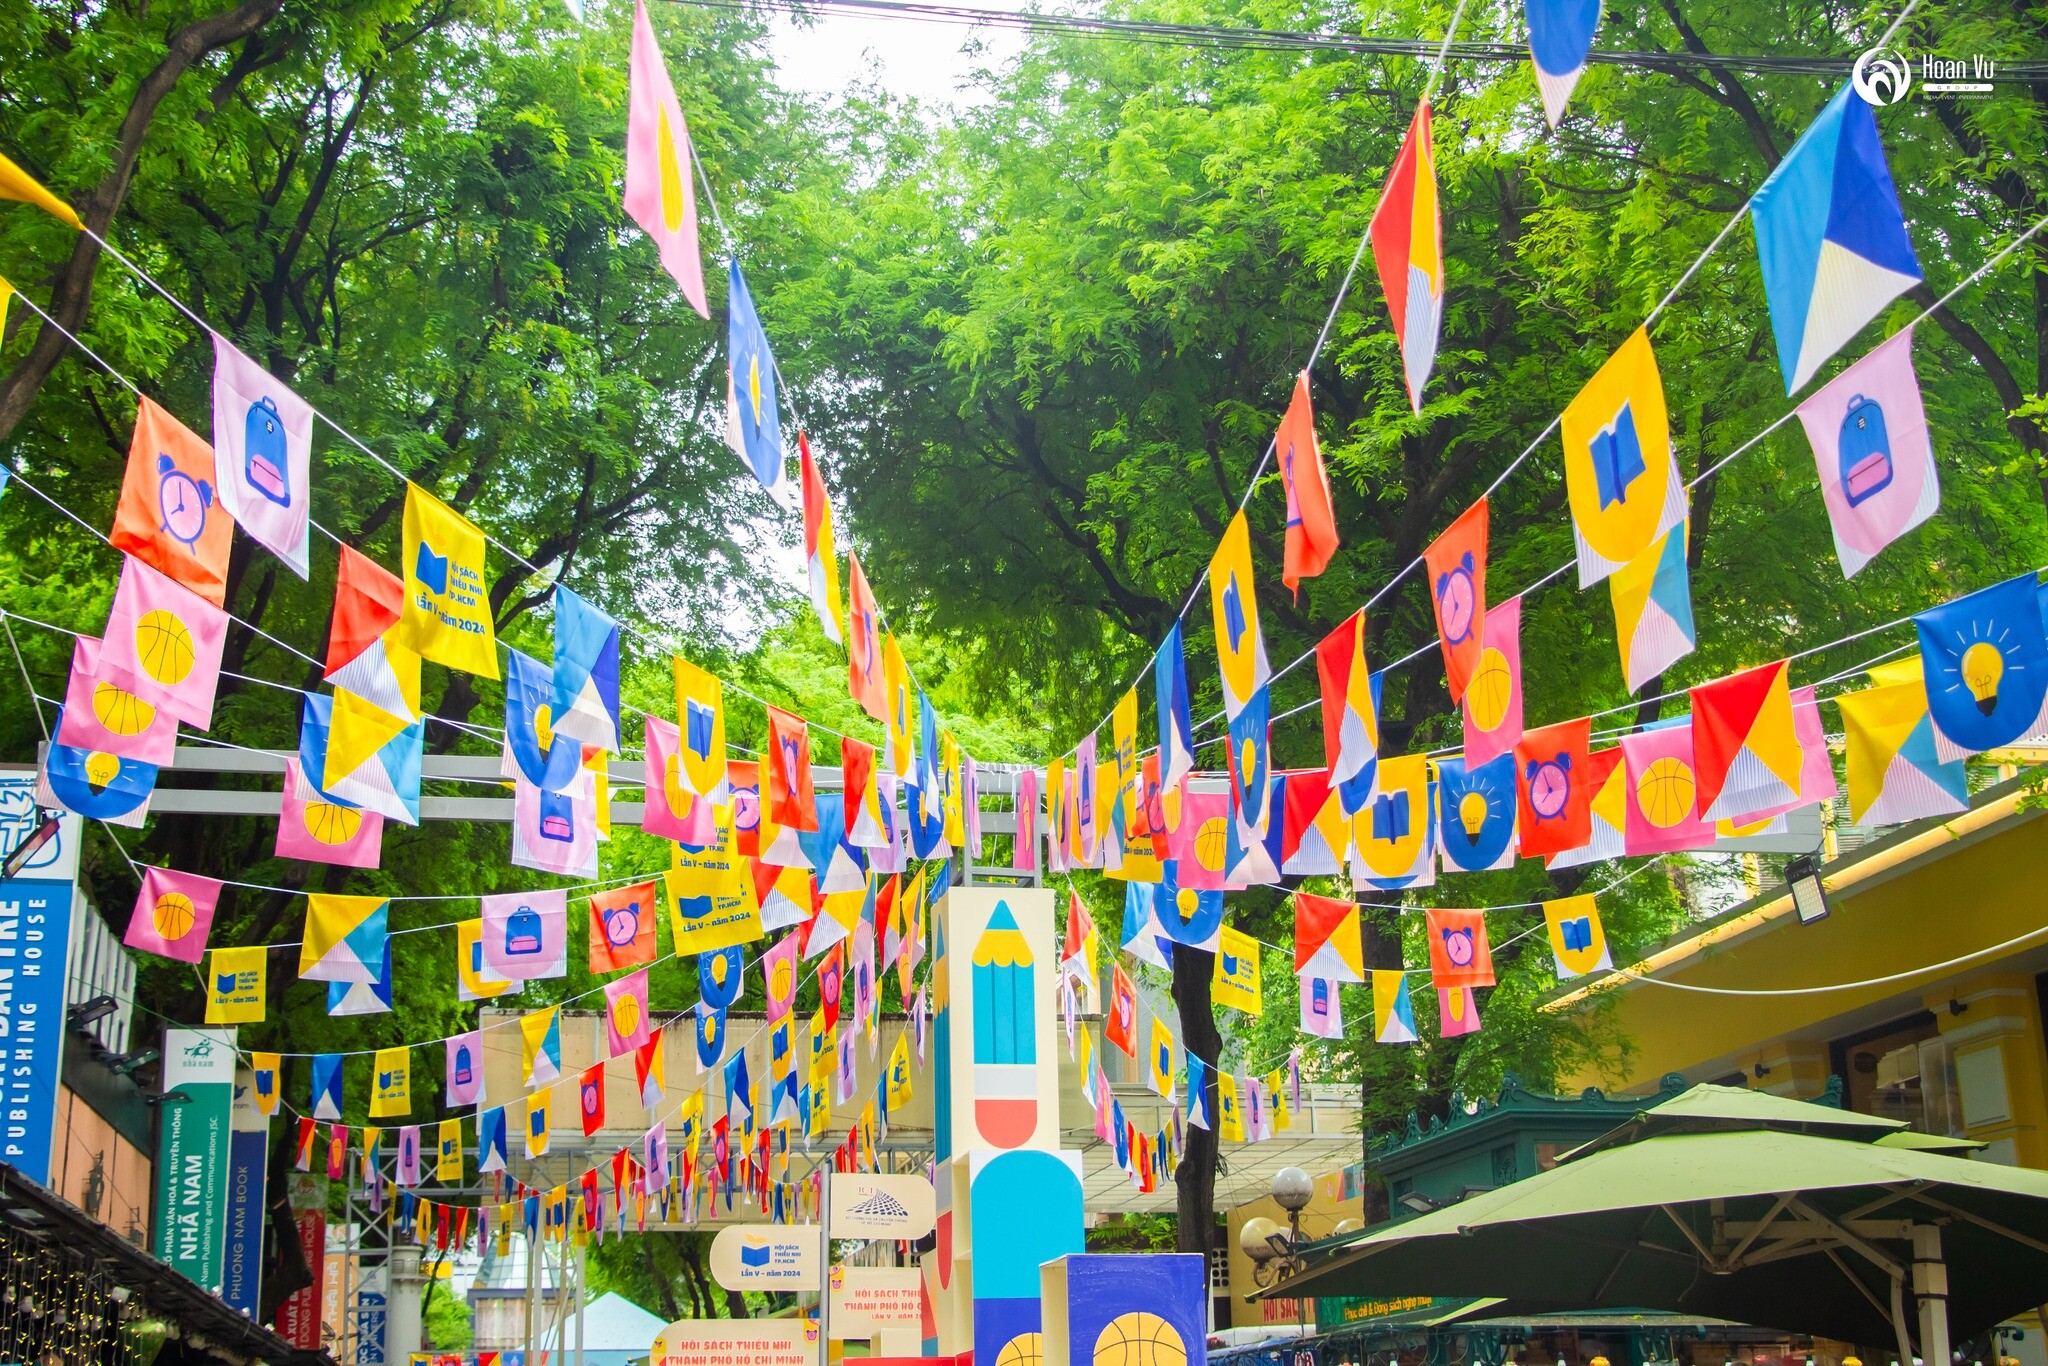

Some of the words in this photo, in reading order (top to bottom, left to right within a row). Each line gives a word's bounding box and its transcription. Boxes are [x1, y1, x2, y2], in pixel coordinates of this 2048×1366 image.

[468, 585, 483, 597] NHI
[458, 618, 486, 636] 2024
[711, 917, 729, 927] năm
[730, 912, 751, 923] 2024
[5, 1003, 37, 1156] PUBLISHING
[22, 899, 47, 976] HOUSE
[171, 1107, 182, 1140] THÔNG
[205, 1131, 217, 1200] Communications
[183, 1155, 203, 1206] NAM
[236, 1166, 248, 1203] BOOK
[205, 1201, 213, 1216] and
[234, 1207, 246, 1239] NAM
[177, 1211, 200, 1260] NHÃ
[202, 1218, 214, 1260] Publishing
[201, 1262, 209, 1282] Nam
[741, 1268, 753, 1277] Lần
[1368, 1302, 1374, 1315] &
[703, 1339, 733, 1350] SÁCH
[772, 1341, 792, 1350] NHI
[775, 1355, 804, 1365] MINH
